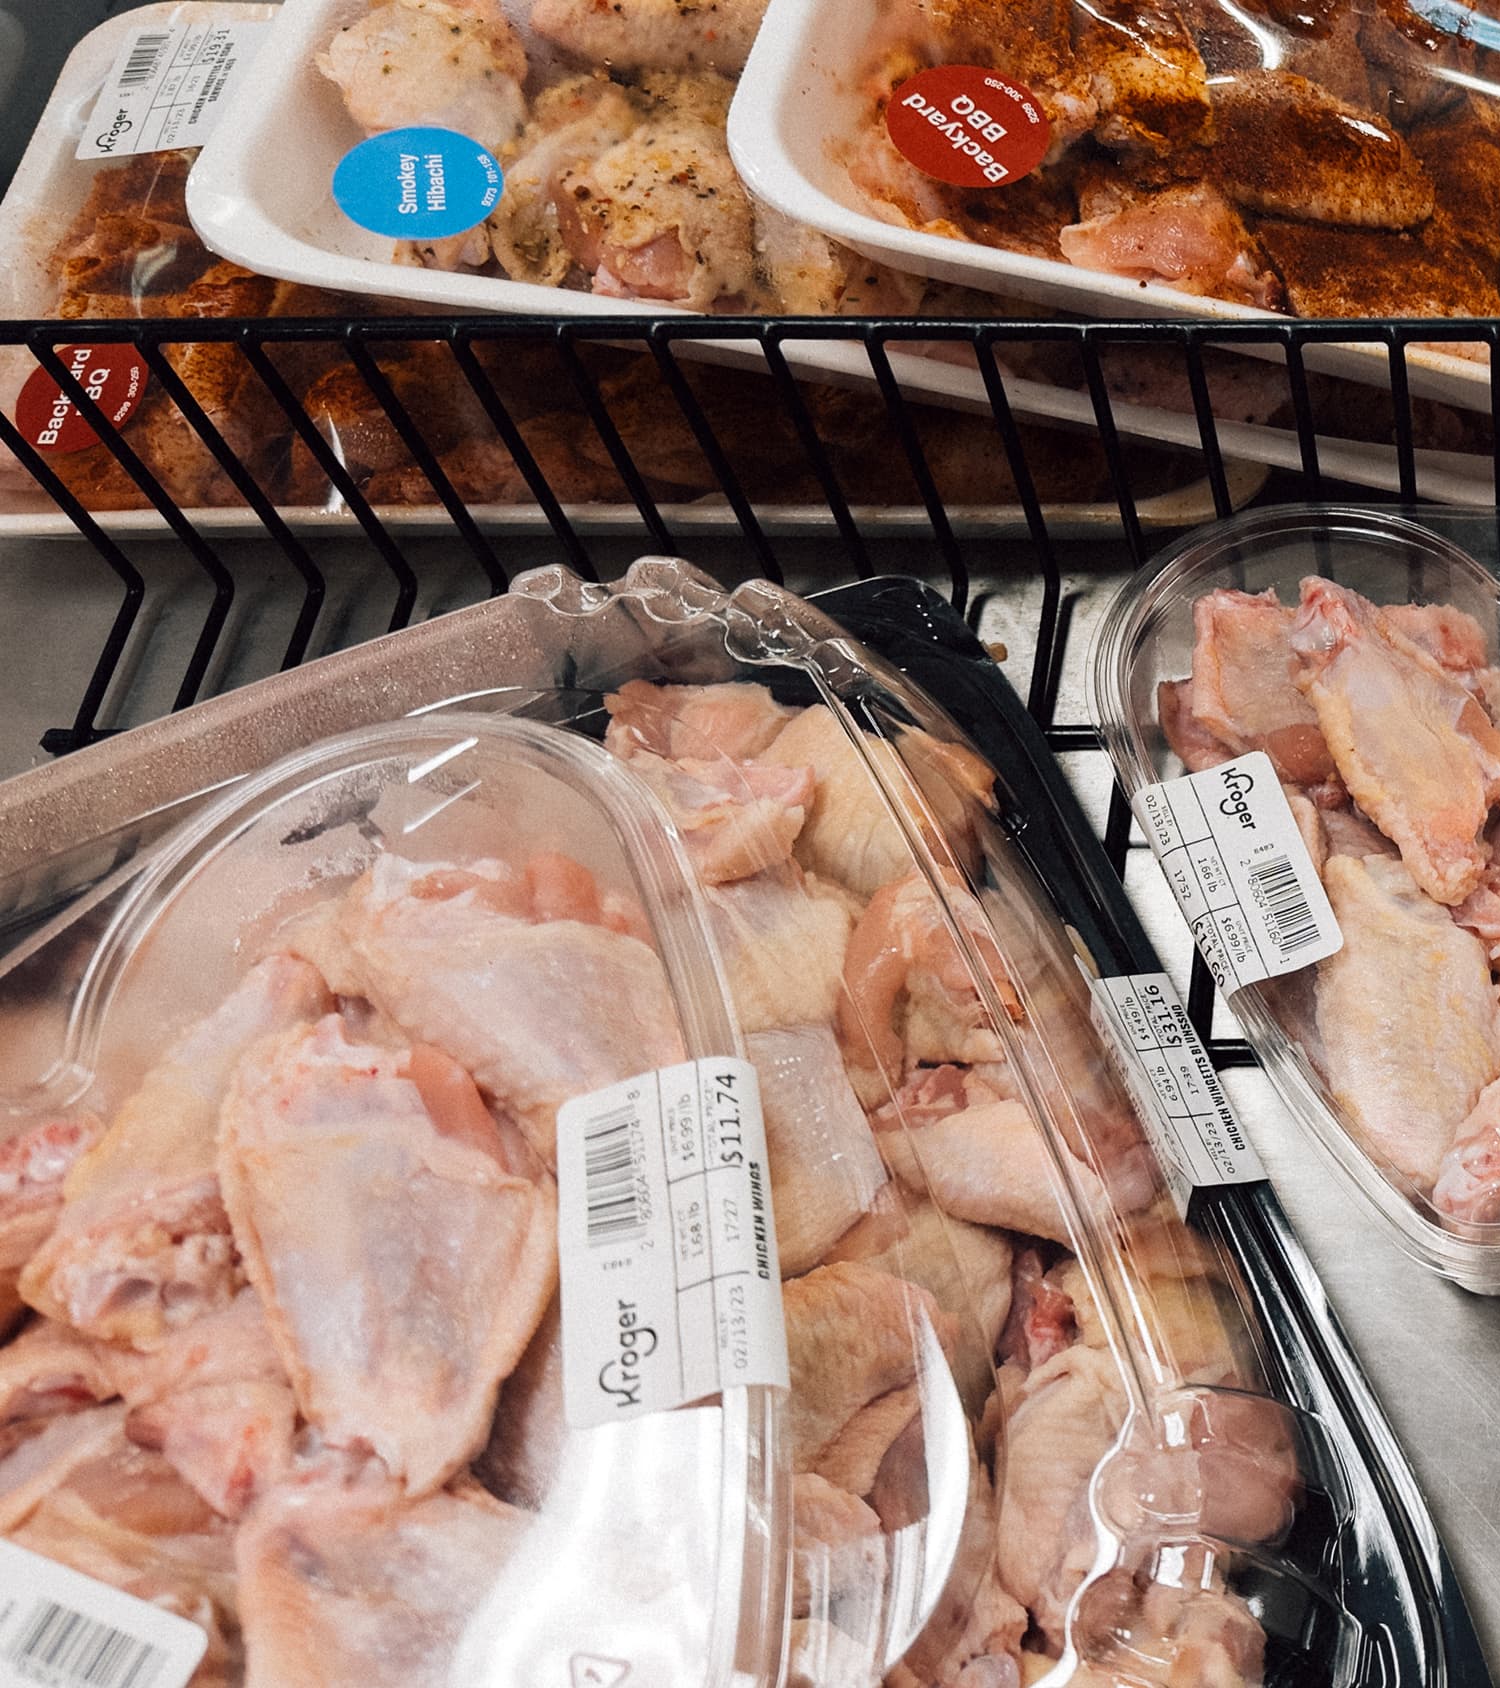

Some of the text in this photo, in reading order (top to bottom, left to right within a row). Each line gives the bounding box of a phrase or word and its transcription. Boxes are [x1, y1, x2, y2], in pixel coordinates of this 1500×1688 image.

[96, 108, 133, 153] Kroger
[901, 92, 1009, 183] Backyard
[951, 94, 1008, 143] BBQ
[397, 153, 420, 214] Smokey
[424, 154, 447, 212] Hibachi
[37, 349, 92, 445] Backard
[1145, 794, 1171, 846] 02/13/23
[1220, 767, 1256, 829] Kroger
[1206, 881, 1217, 893] lb
[1262, 913, 1283, 945] 51160
[1124, 996, 1151, 1041] $4.49/lb
[1144, 984, 1182, 1045] $31.16
[1156, 1066, 1166, 1078] lb
[1189, 1044, 1202, 1056] BI
[1195, 1056, 1224, 1108] WINGETTS
[715, 1073, 744, 1164] $11.74
[1218, 1107, 1246, 1151] CHICKEN
[1204, 1122, 1236, 1174] 02/13/23
[688, 1202, 700, 1219] lb
[748, 1161, 770, 1281] CHICKEN WINGS
[729, 1285, 747, 1369] 02/13/23
[599, 1300, 659, 1408] Kroger
